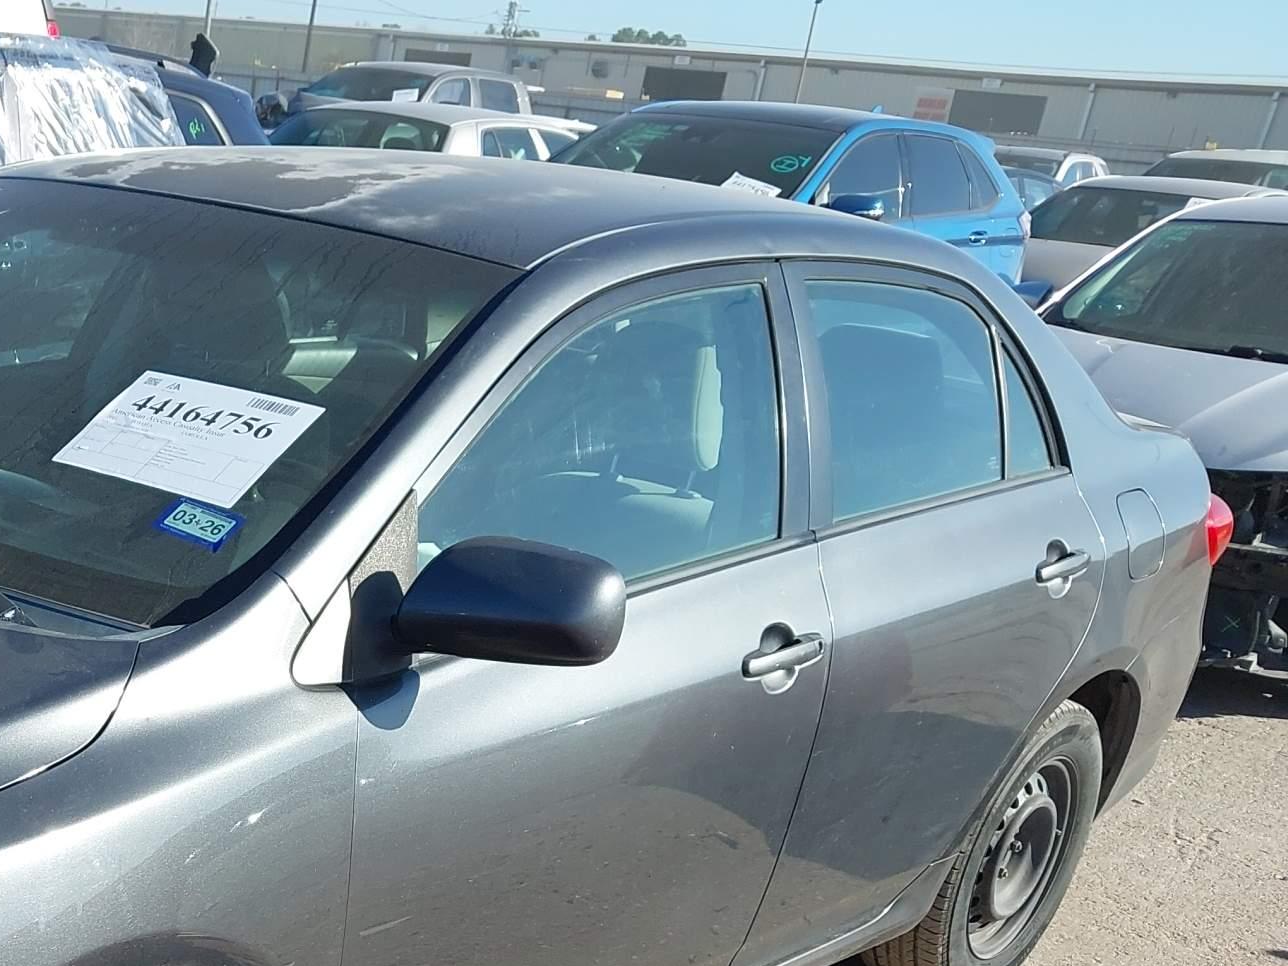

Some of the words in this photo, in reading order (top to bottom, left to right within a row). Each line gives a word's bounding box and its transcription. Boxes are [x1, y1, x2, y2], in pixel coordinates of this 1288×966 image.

[112, 408, 146, 421] American
[131, 394, 281, 441] 44164756
[172, 510, 197, 526] 03
[199, 520, 225, 536] 26
